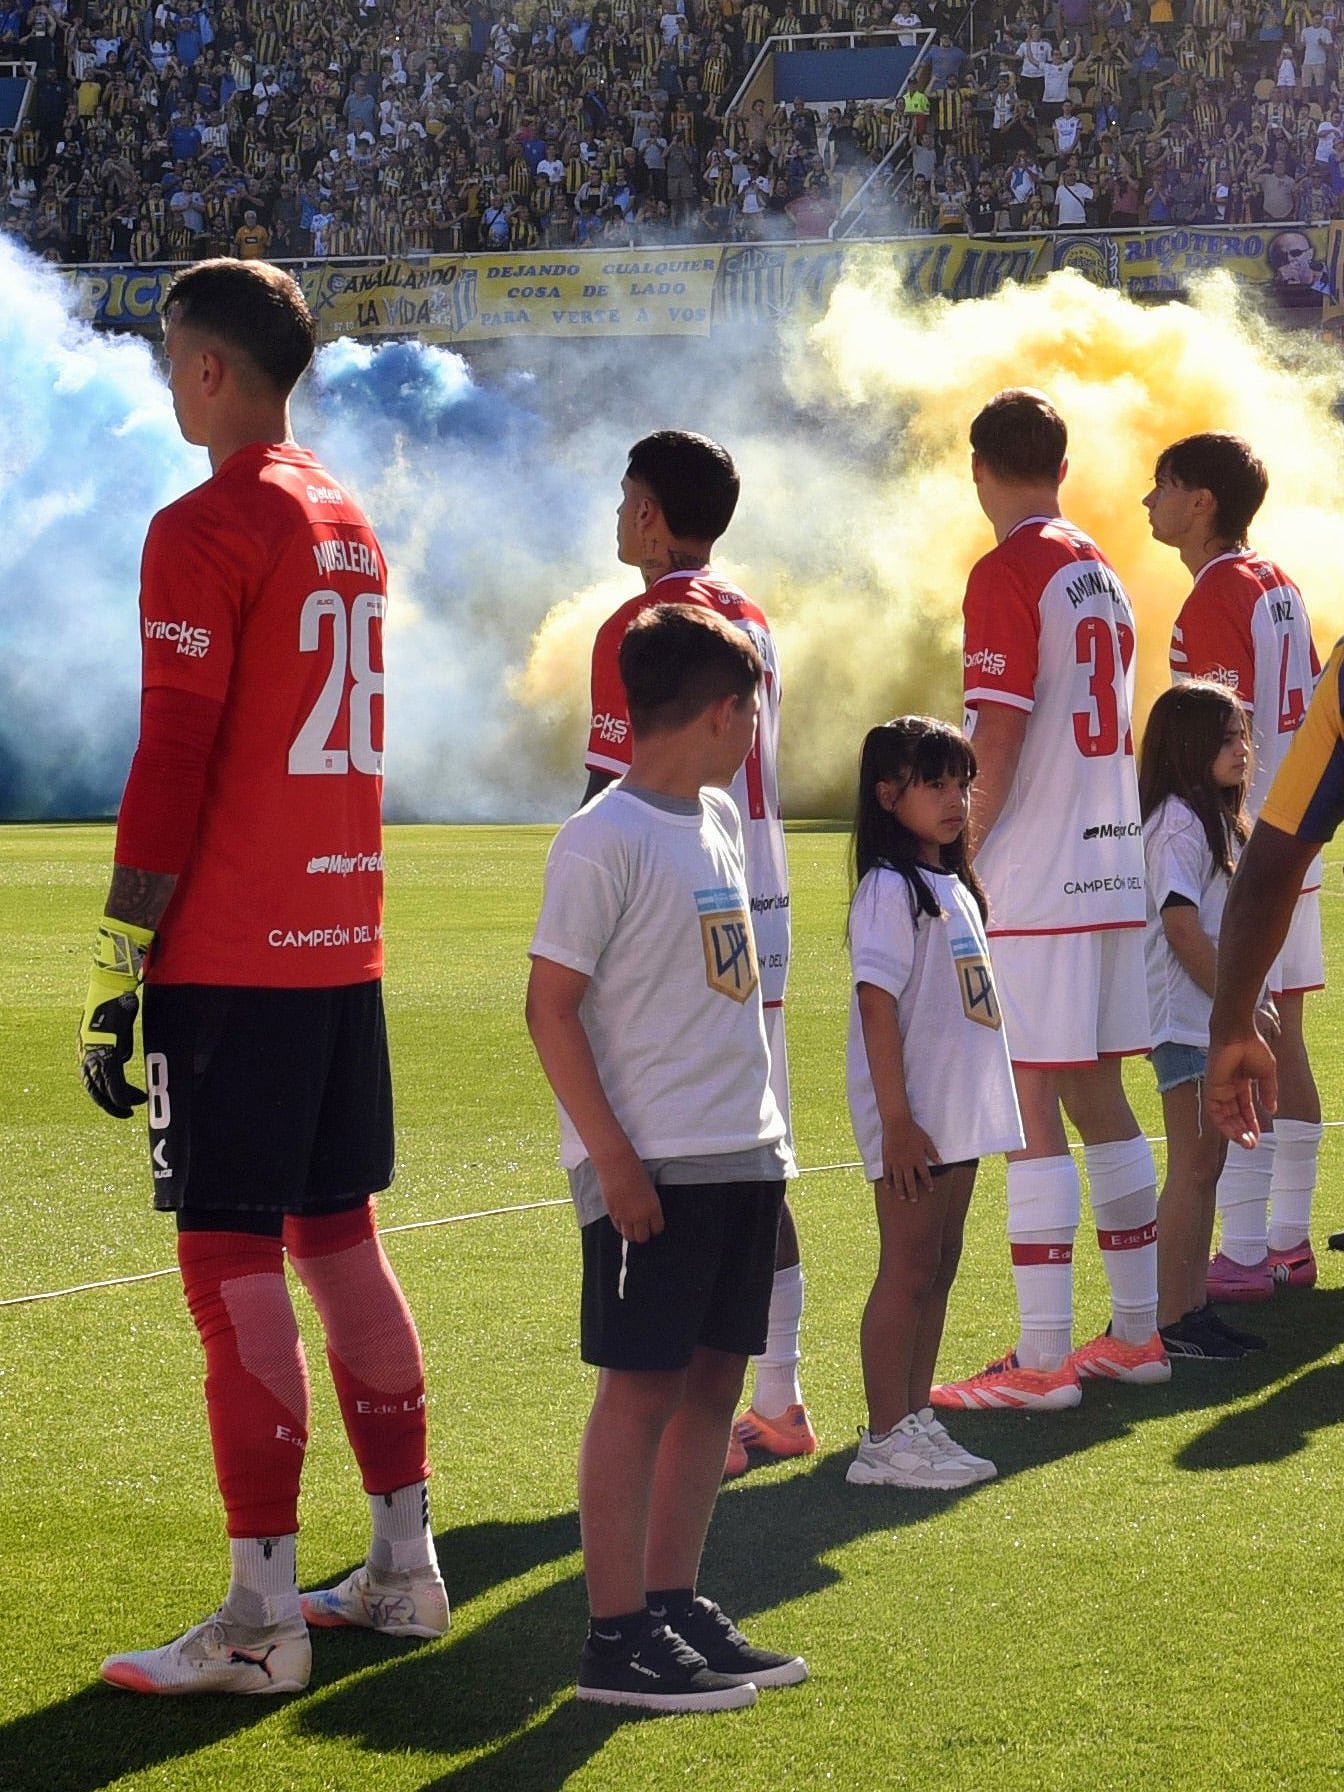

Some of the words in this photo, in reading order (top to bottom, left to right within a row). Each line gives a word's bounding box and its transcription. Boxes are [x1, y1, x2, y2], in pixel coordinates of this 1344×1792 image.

[1124, 231, 1265, 262] RICOTERO
[487, 263, 581, 279] DEJANDO
[602, 259, 715, 276] CUALQUIER
[507, 286, 561, 299] COSA
[583, 285, 609, 298] DE
[630, 283, 687, 296] LADO
[358, 300, 380, 328] LA
[480, 309, 531, 326] PARA
[552, 308, 621, 324] VERTE
[668, 307, 706, 322] VOS
[312, 539, 379, 581] MUSLERA
[176, 643, 208, 658] M2V
[288, 589, 386, 775] 28
[591, 712, 629, 737] cks
[600, 729, 626, 744] M2V
[268, 924, 350, 948] CAMPEÓN
[353, 925, 372, 944] DEL
[356, 1400, 372, 1414] E
